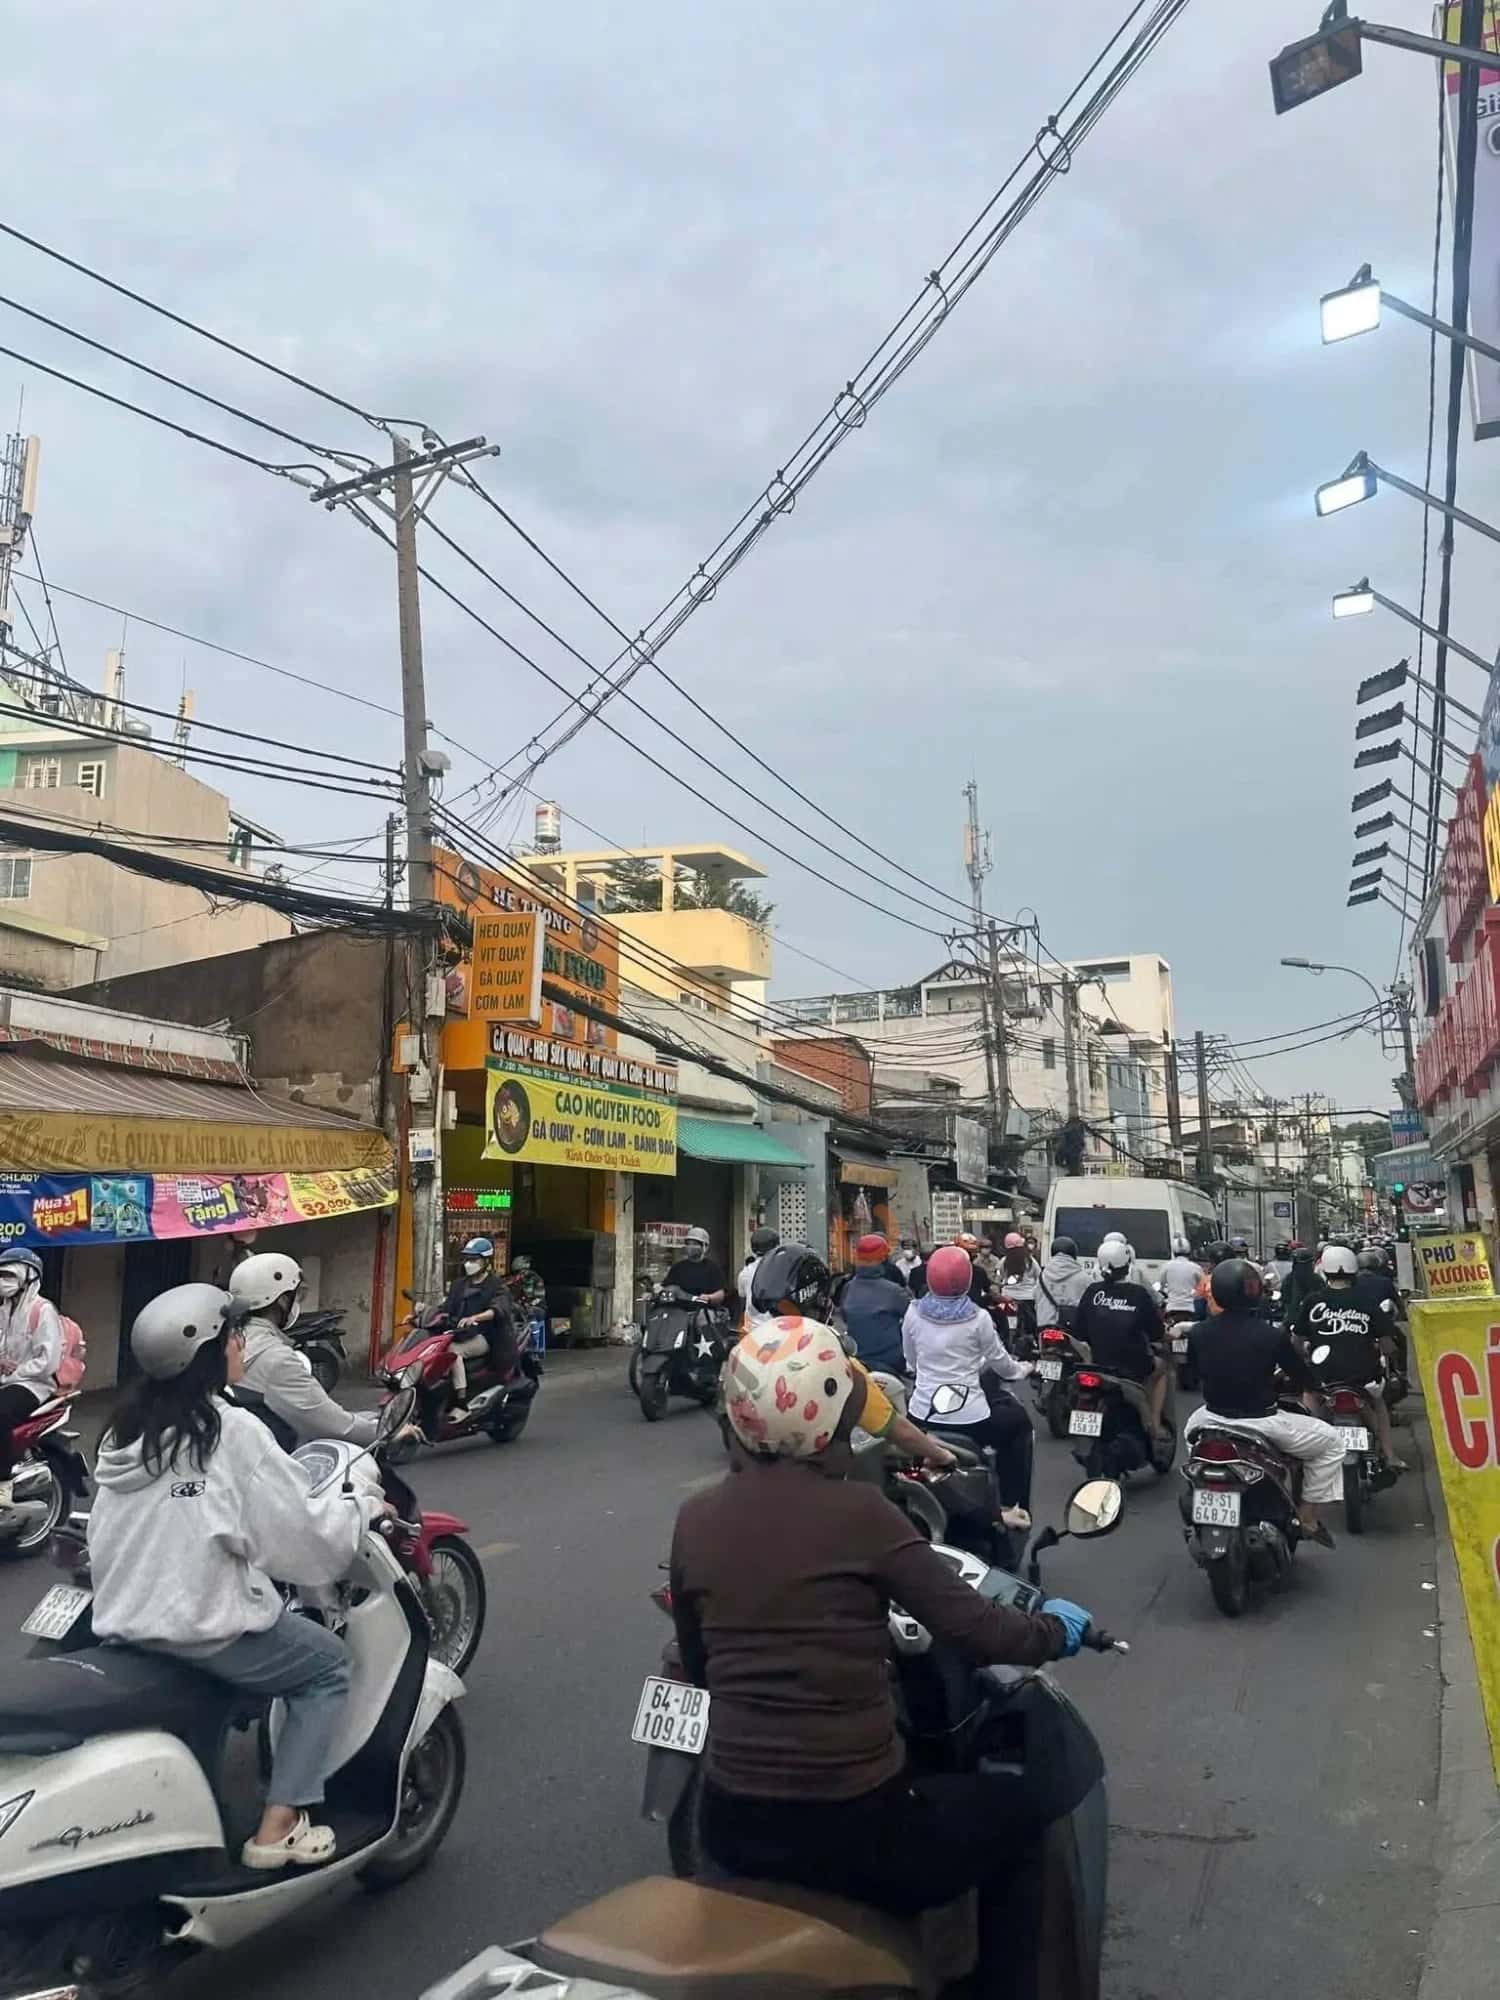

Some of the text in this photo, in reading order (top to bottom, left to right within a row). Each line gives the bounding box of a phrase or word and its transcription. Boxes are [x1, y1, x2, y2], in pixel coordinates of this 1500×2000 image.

[479, 921, 531, 938] HEO QUAY
[499, 946, 527, 962] QUAY
[496, 971, 525, 986] QUAY
[475, 994, 524, 1011] CƠM LAM
[507, 1031, 528, 1057] QUAY
[533, 1039, 549, 1063] HEO
[555, 1091, 582, 1116] CAO
[632, 1109, 661, 1128] FOOD
[532, 1117, 546, 1139] GÀ
[550, 1124, 575, 1143] QUAY
[583, 1125, 605, 1147] CƠM
[607, 1130, 626, 1148] LAM
[125, 1132, 172, 1165] QUAY
[33, 1197, 63, 1212] Mua
[1422, 1240, 1456, 1264] PHỞ
[1428, 1263, 1490, 1286] XƯƠNG
[651, 1684, 703, 1717] 64-DB
[642, 1711, 701, 1748] 109.49
